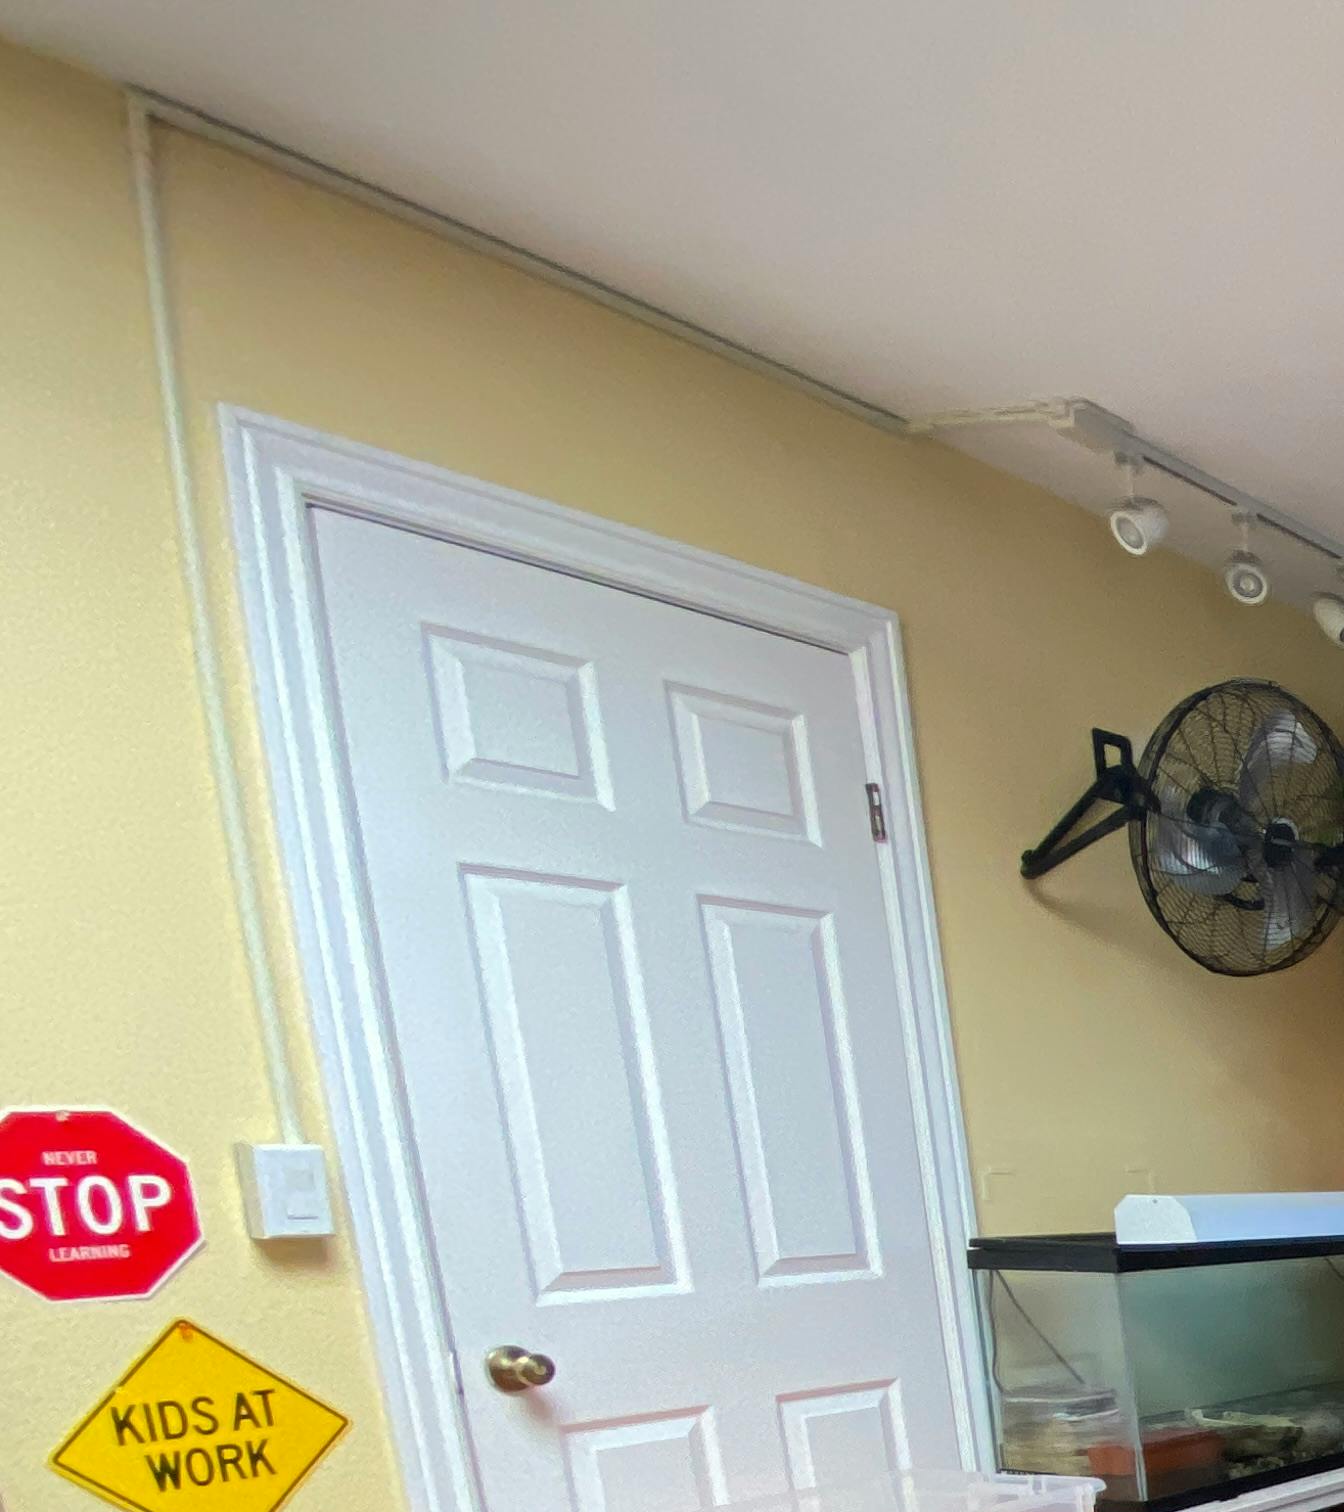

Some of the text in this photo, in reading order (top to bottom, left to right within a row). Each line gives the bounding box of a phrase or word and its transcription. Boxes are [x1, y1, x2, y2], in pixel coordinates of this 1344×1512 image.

[42, 1150, 98, 1166] NEVER
[0, 1174, 172, 1241] STOP
[48, 1243, 132, 1263] LEARNING
[110, 1388, 277, 1447] KIDS AT
[144, 1438, 279, 1493] WORK
